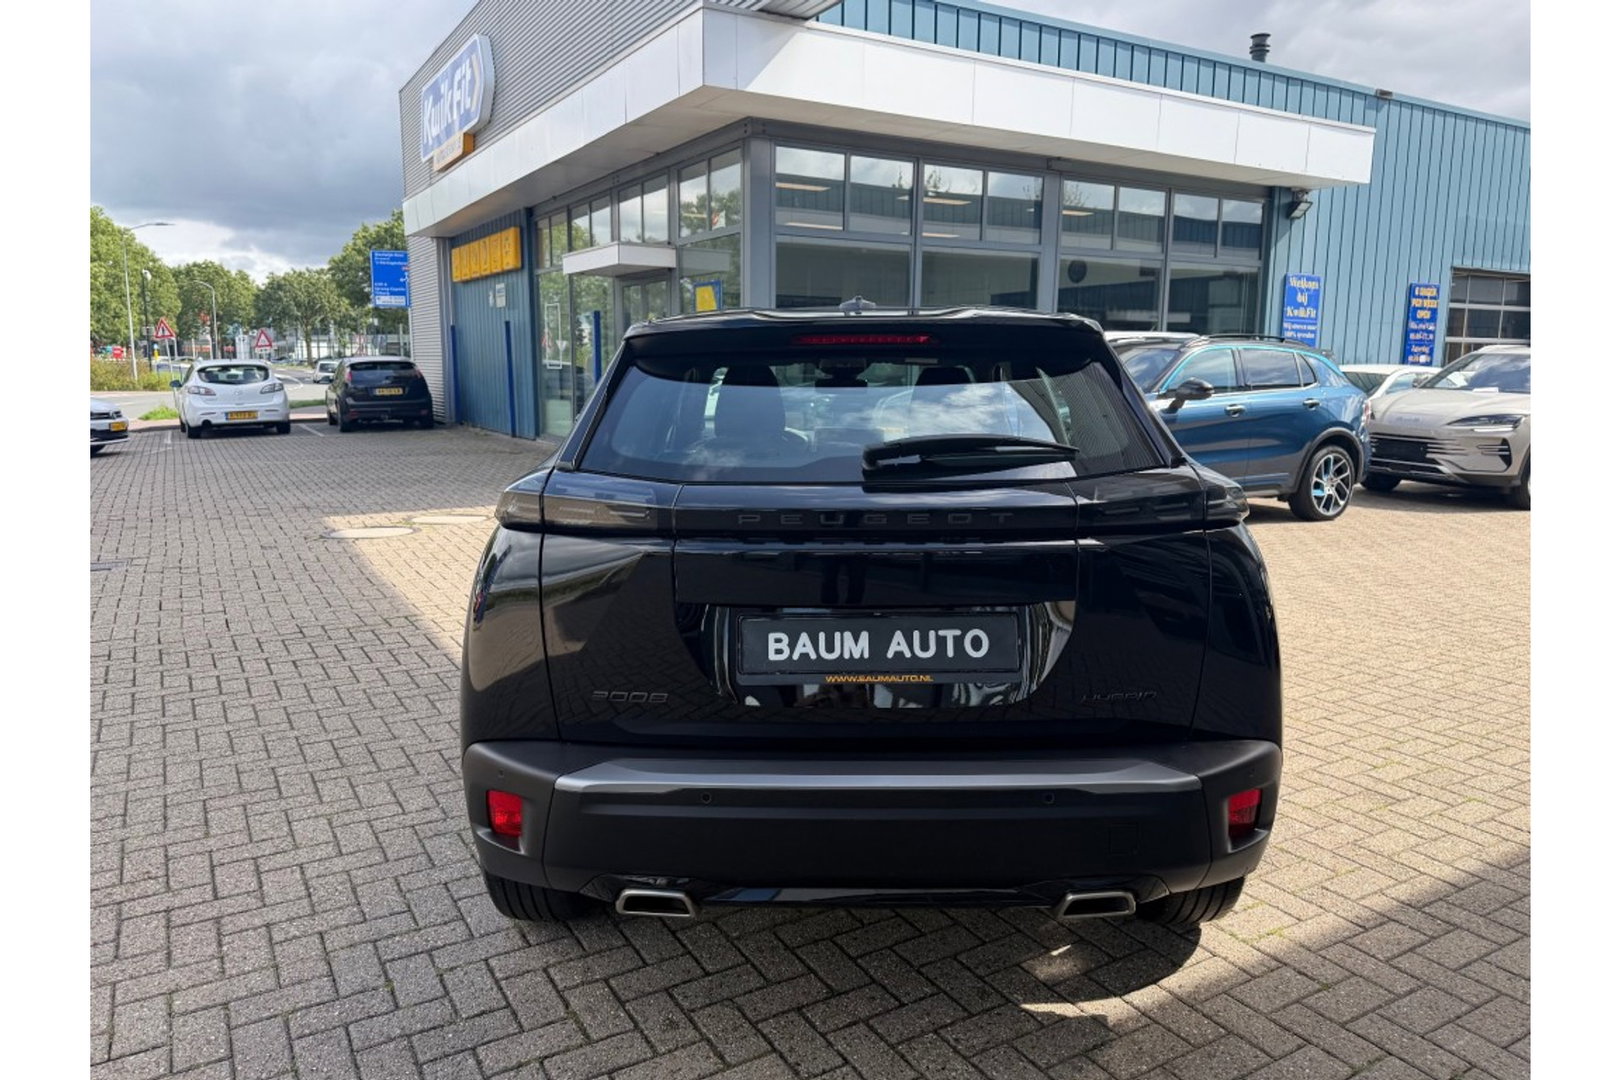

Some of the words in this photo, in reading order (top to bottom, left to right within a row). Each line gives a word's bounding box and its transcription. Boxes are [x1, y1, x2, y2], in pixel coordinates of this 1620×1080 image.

[1296, 291, 1309, 306] bij
[738, 512, 1014, 526] PEUGEOT
[767, 630, 870, 661] BAUM
[886, 628, 990, 659] AUTO
[825, 674, 934, 683] WWW.BAUMAUTO.NL
